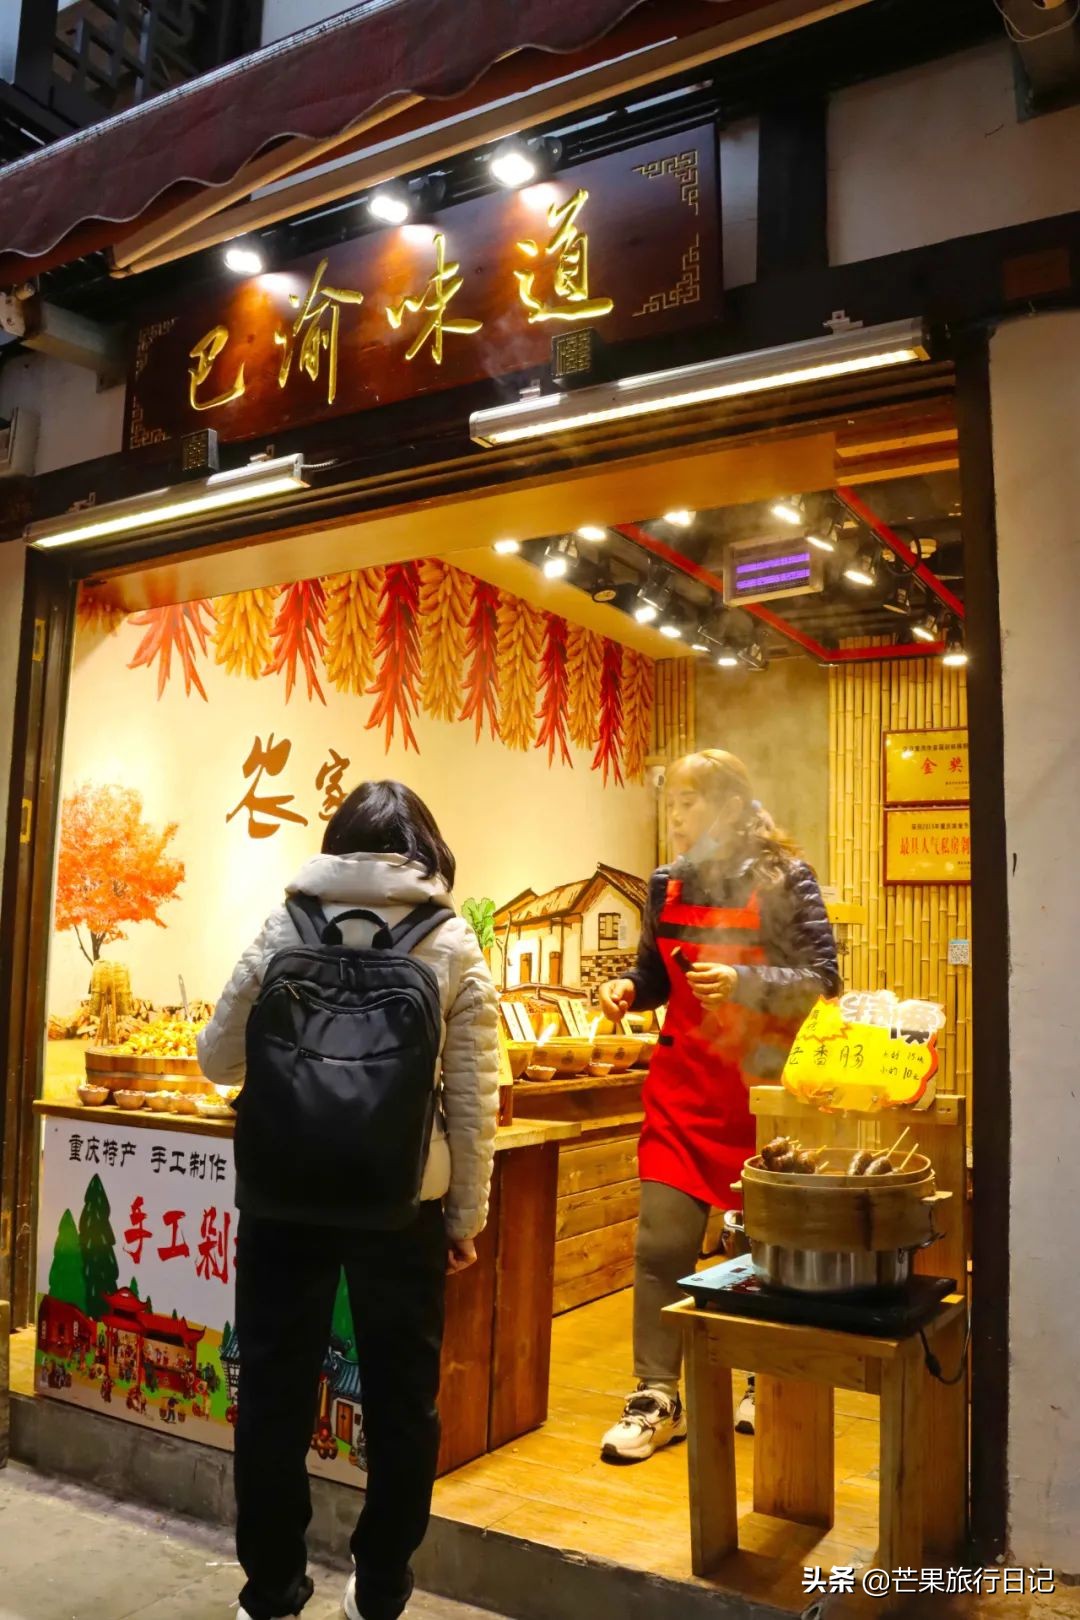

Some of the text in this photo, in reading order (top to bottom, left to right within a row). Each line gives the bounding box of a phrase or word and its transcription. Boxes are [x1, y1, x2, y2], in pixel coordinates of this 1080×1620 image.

[188, 188, 613, 411] 巴渝味道
[69, 1134, 228, 1183] 重庆特产 手工制作
[123, 1196, 239, 1284] 手工剁
